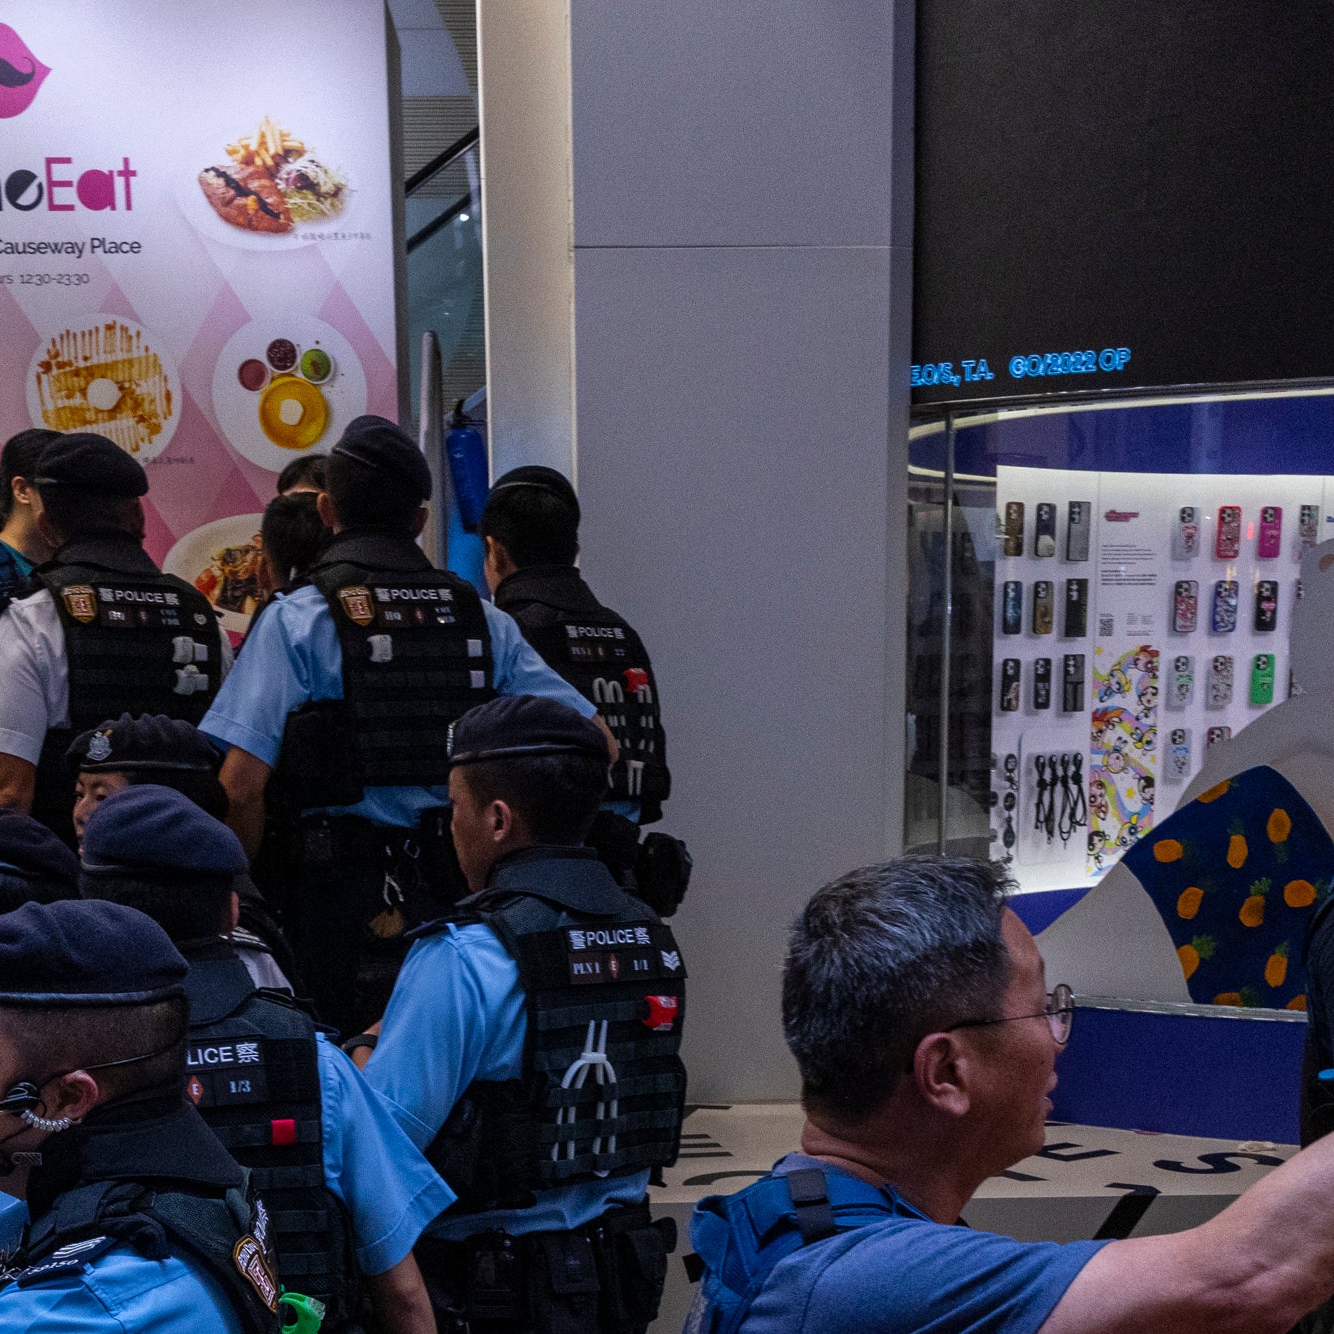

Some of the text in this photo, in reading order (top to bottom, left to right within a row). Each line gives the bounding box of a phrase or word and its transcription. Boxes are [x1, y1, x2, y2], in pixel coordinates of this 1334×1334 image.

[90, 237, 142, 255] Place
[115, 590, 165, 604] POLICE
[390, 588, 439, 601] POLICE
[578, 626, 614, 638] POLICE
[586, 929, 636, 947] POLICE
